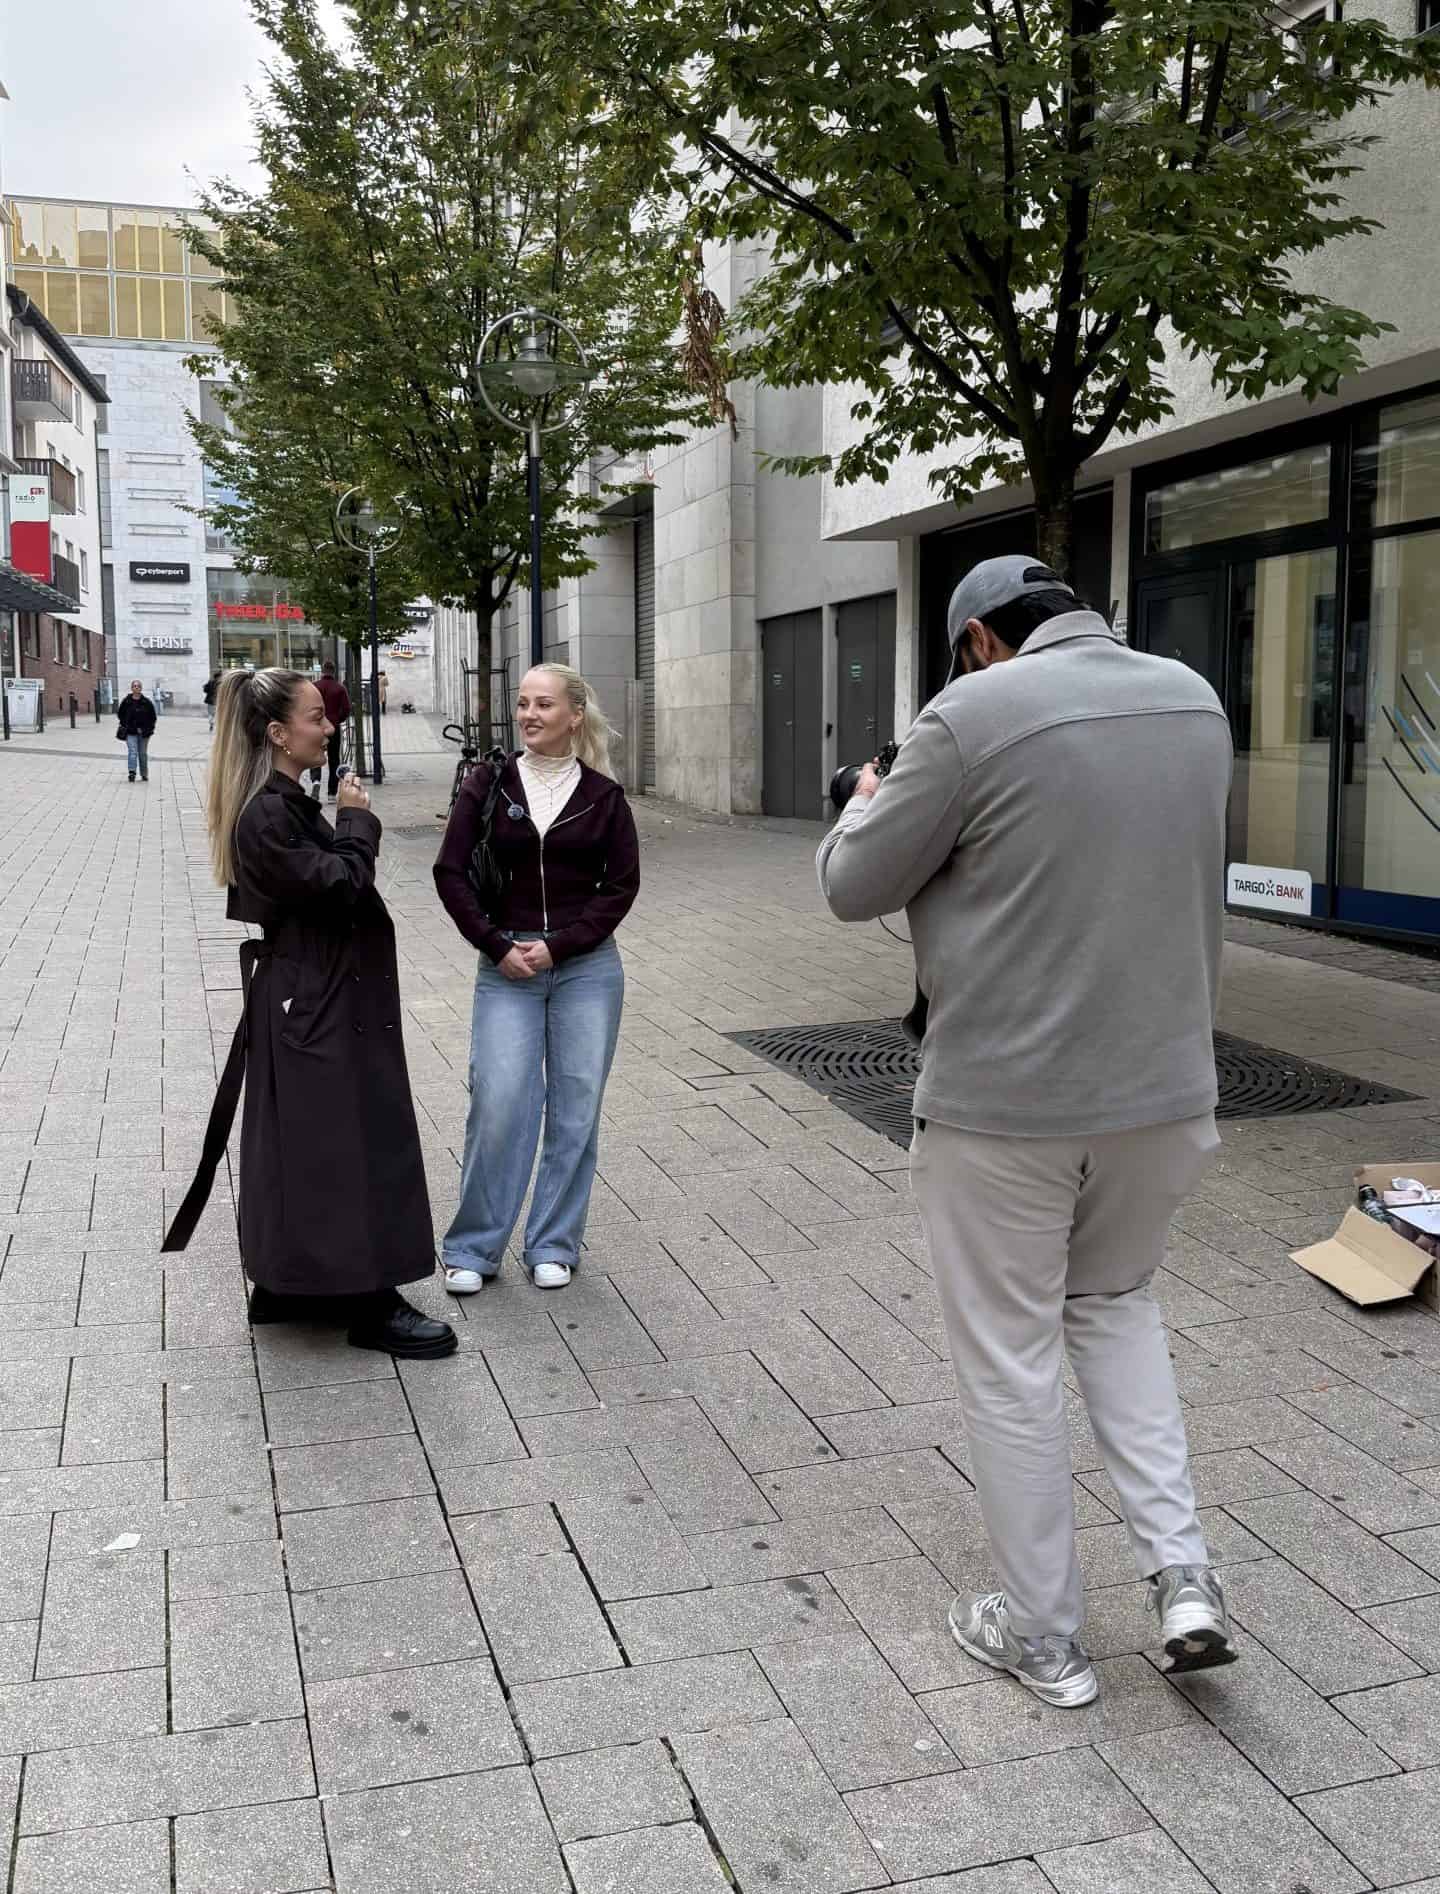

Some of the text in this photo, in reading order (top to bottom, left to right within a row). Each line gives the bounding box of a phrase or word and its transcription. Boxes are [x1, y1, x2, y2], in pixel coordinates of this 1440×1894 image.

[147, 568, 184, 576] cyberport
[140, 636, 188, 649] CHRIST
[393, 643, 411, 652] dm
[1233, 880, 1305, 900] TARGO BANK
